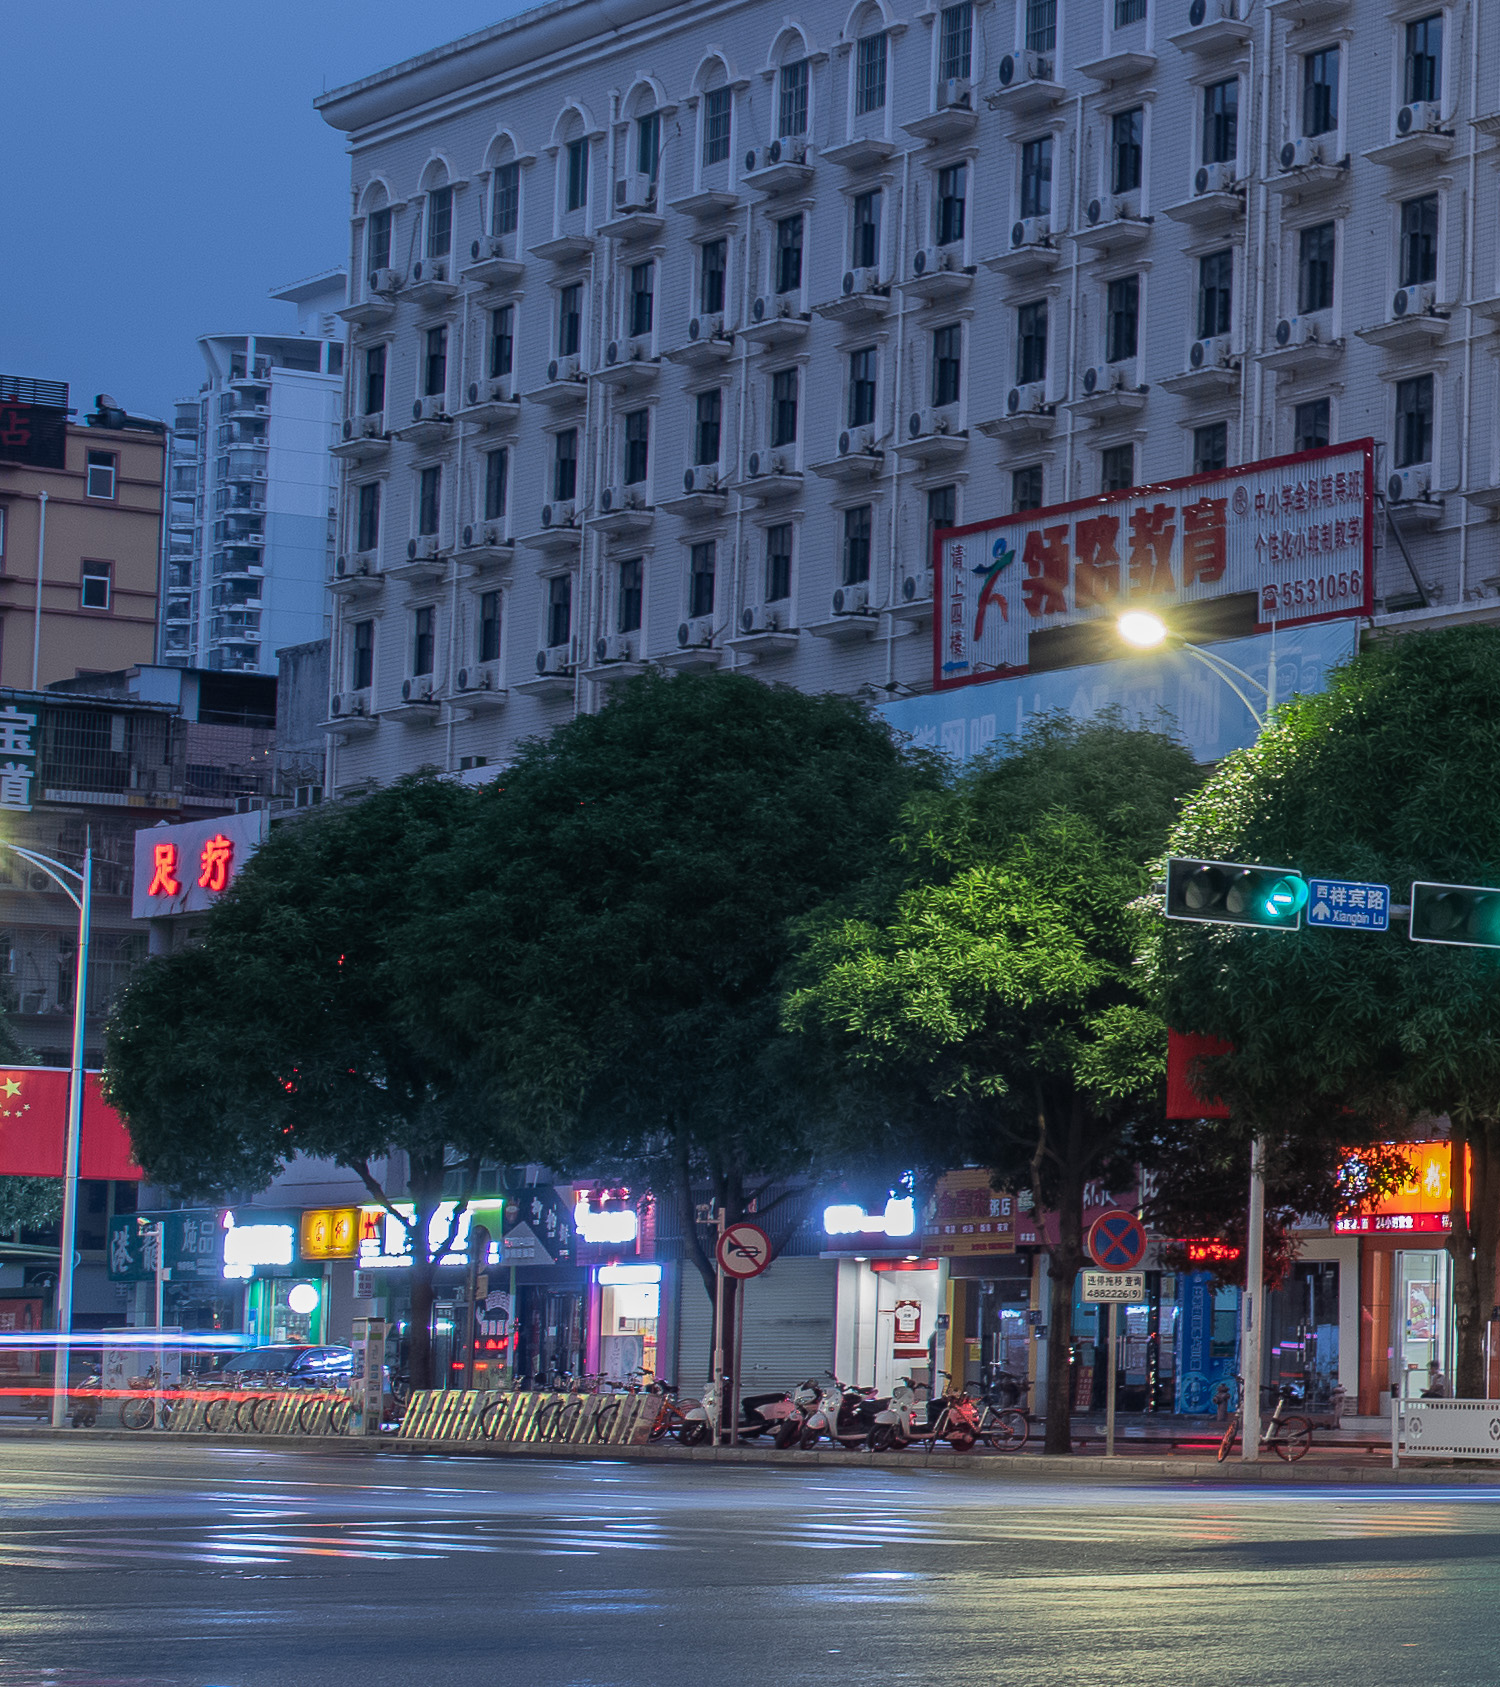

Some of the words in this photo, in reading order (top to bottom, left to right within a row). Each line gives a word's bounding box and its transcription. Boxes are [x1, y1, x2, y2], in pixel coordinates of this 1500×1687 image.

[1254, 469, 1362, 520] 中小学全科辅导班
[1022, 498, 1228, 617] 领路教育
[1254, 516, 1362, 564] 个性化小班制教学
[950, 544, 966, 657] 请上四楼
[1281, 569, 1362, 607] 5531056
[148, 833, 235, 897] 足疗
[1329, 886, 1385, 910] 祥宾路
[1332, 910, 1370, 926] Xiangbin
[1373, 912, 1384, 925] Lu
